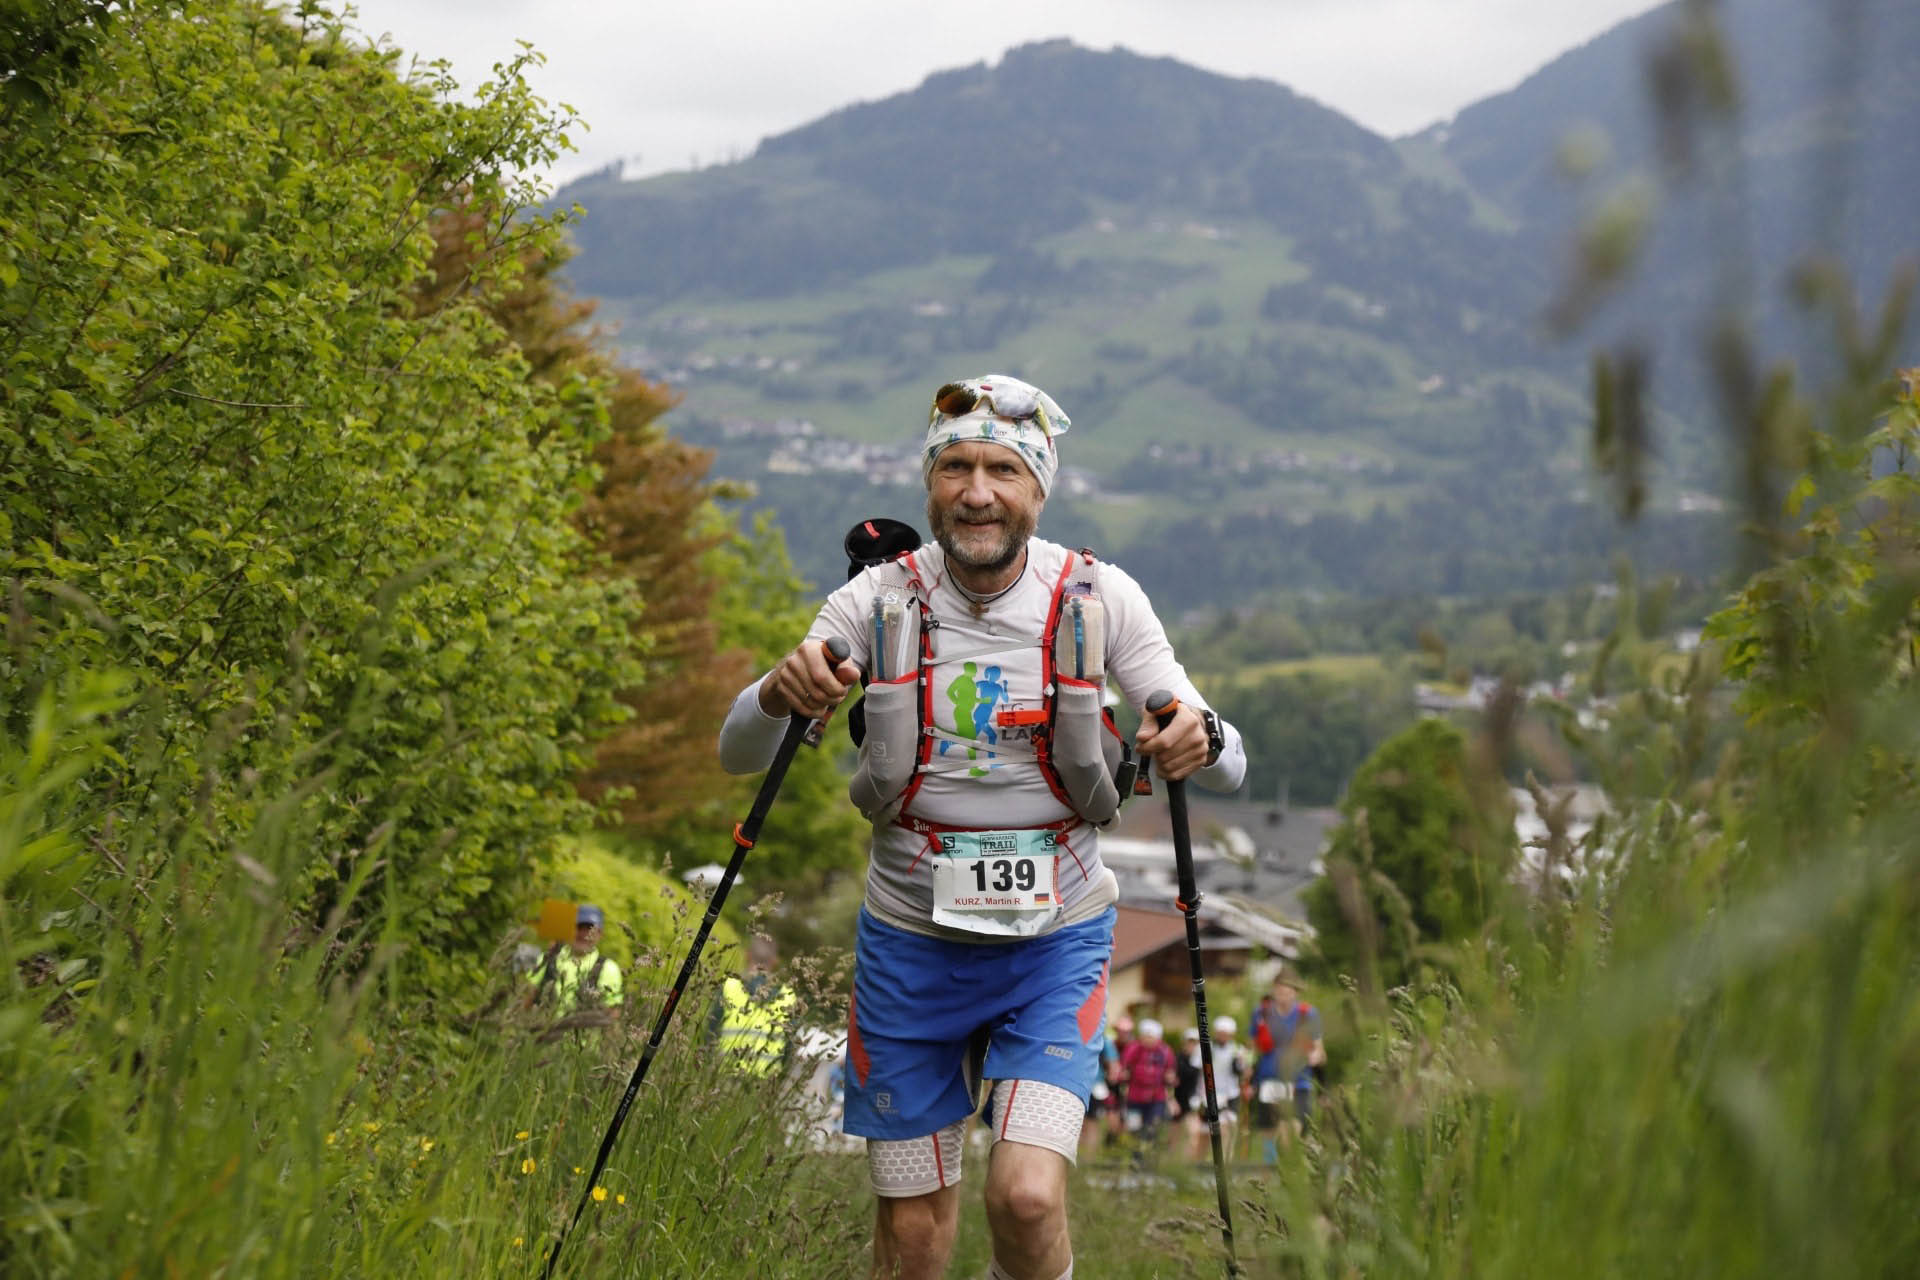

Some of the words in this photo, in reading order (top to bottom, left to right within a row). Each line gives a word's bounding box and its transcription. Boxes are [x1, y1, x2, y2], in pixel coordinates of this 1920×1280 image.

[982, 840, 1016, 850] TRAIL
[970, 859, 1036, 892] 139
[985, 897, 1012, 905] Martin
